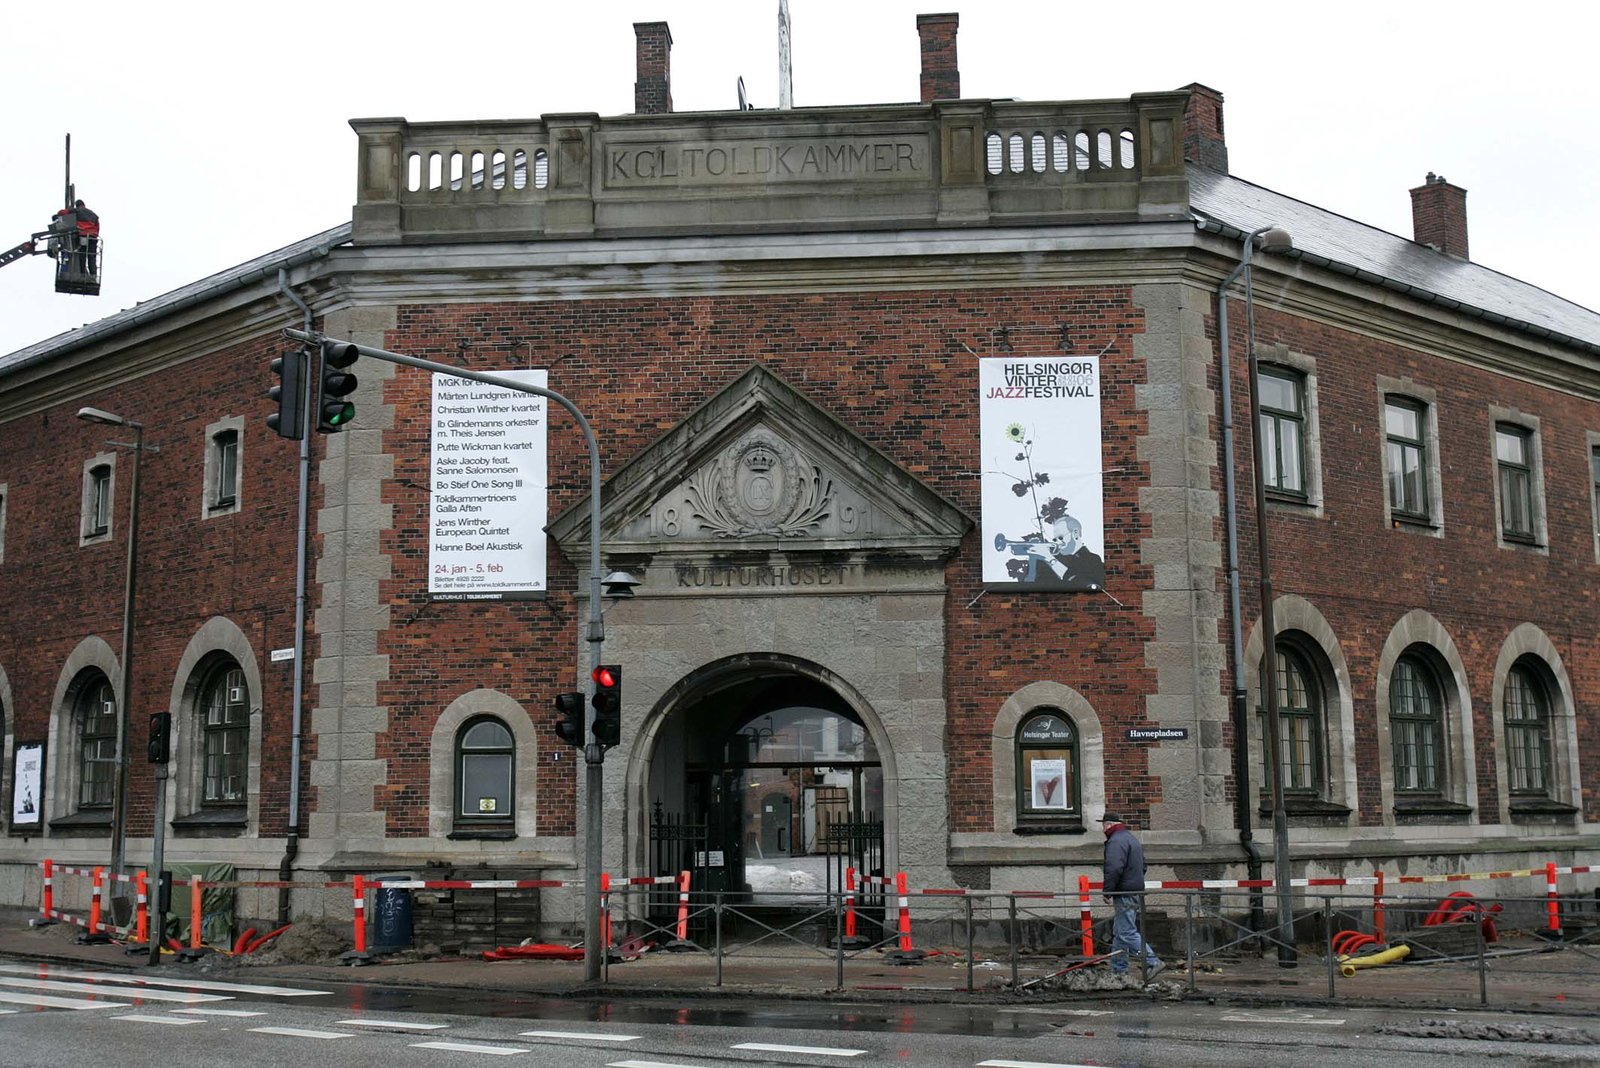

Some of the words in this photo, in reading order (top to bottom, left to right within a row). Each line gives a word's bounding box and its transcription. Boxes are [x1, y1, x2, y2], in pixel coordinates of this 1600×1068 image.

[1004, 363, 1093, 375] HELSINGØR
[438, 379, 460, 387] MGK
[1005, 375, 1057, 387] VINTER
[470, 391, 511, 402] Lundgren
[437, 405, 475, 414] Christian
[477, 405, 510, 413] Winther
[512, 404, 540, 412] kvartet
[437, 420, 445, 428] Ib
[447, 419, 503, 428] Glindemanns
[505, 418, 540, 427] orkester
[450, 429, 473, 438] Theis
[474, 429, 506, 437] Jensen
[437, 443, 459, 451] Putte
[461, 442, 501, 451] Wickman
[503, 441, 533, 450] kvartet
[436, 457, 458, 465] Aske
[459, 457, 490, 467] Jacoby
[492, 456, 510, 465] feat.
[436, 466, 463, 475] Sanne
[465, 466, 519, 475] Salomonsen
[436, 481, 448, 490] Bo
[450, 480, 469, 489] Stief
[471, 480, 489, 489] One
[491, 479, 514, 490] Song
[435, 494, 517, 503] Toldkammertrioens
[435, 504, 457, 513] Galla
[459, 504, 482, 512] Aften
[435, 518, 456, 527] Jens
[458, 518, 491, 526] Winther
[645, 506, 681, 537] 18
[839, 503, 873, 535] 91
[435, 528, 477, 538] European
[478, 527, 510, 536] Quintet
[435, 543, 463, 552] Hanne
[465, 542, 485, 551] Boel
[486, 542, 523, 551] Akustisk
[434, 564, 449, 574] 24.
[450, 564, 467, 575] jan
[476, 563, 485, 573] 5.
[487, 563, 504, 573] feb
[678, 566, 849, 587] KULTURHUSET
[1130, 729, 1184, 739] Havnepladsen
[554, 752, 559, 761] 1
